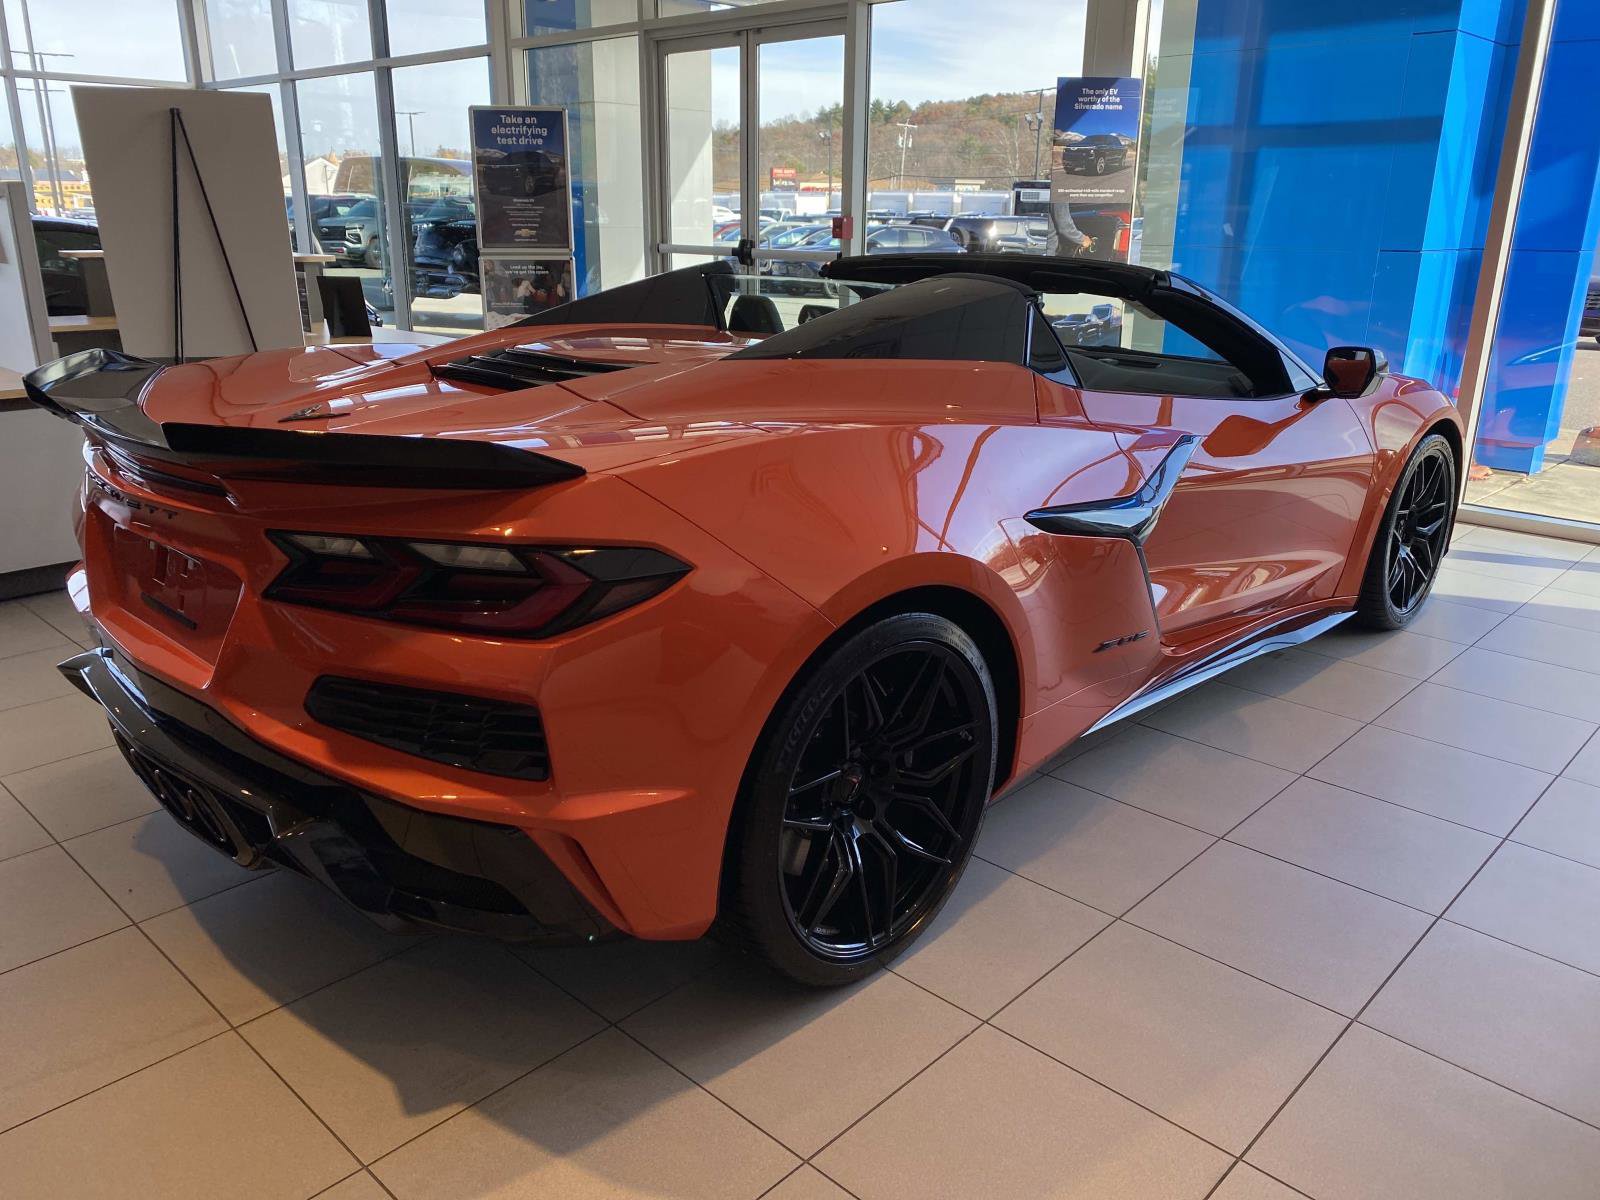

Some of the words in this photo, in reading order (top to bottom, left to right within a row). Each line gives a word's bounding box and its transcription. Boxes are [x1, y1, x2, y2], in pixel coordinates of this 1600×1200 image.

[1095, 88, 1108, 96] only
[500, 115, 523, 124] Take
[525, 116, 537, 124] an
[491, 125, 548, 136] electrifying
[497, 136, 517, 145] test
[519, 136, 543, 145] drive
